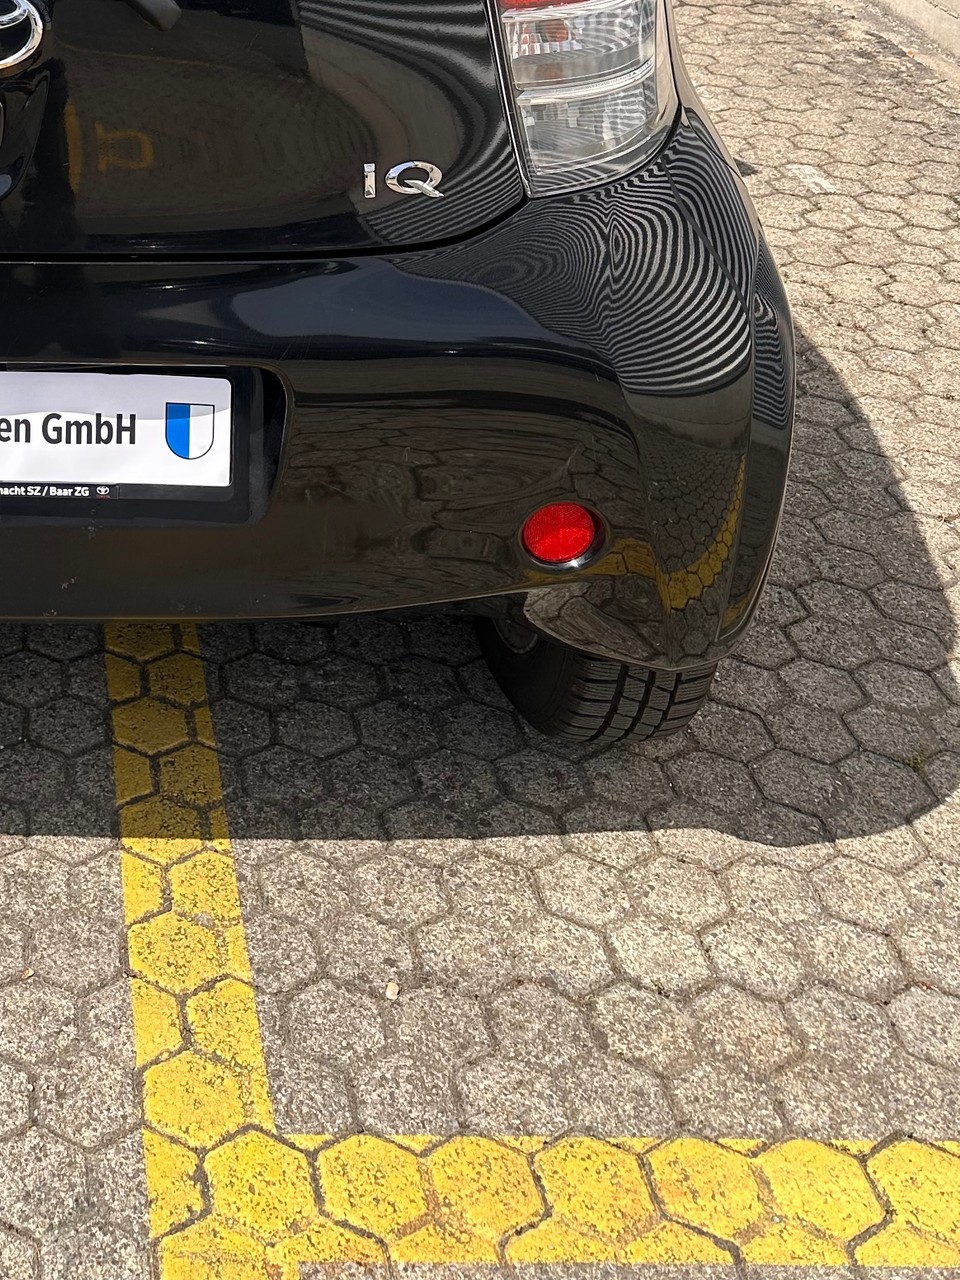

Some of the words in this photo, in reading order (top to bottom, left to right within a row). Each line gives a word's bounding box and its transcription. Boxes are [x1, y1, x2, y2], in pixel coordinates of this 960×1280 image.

[41, 412, 137, 445] GmbH
[26, 486, 42, 496] SZ
[49, 486, 73, 497] Baar
[74, 486, 90, 497] ZG
